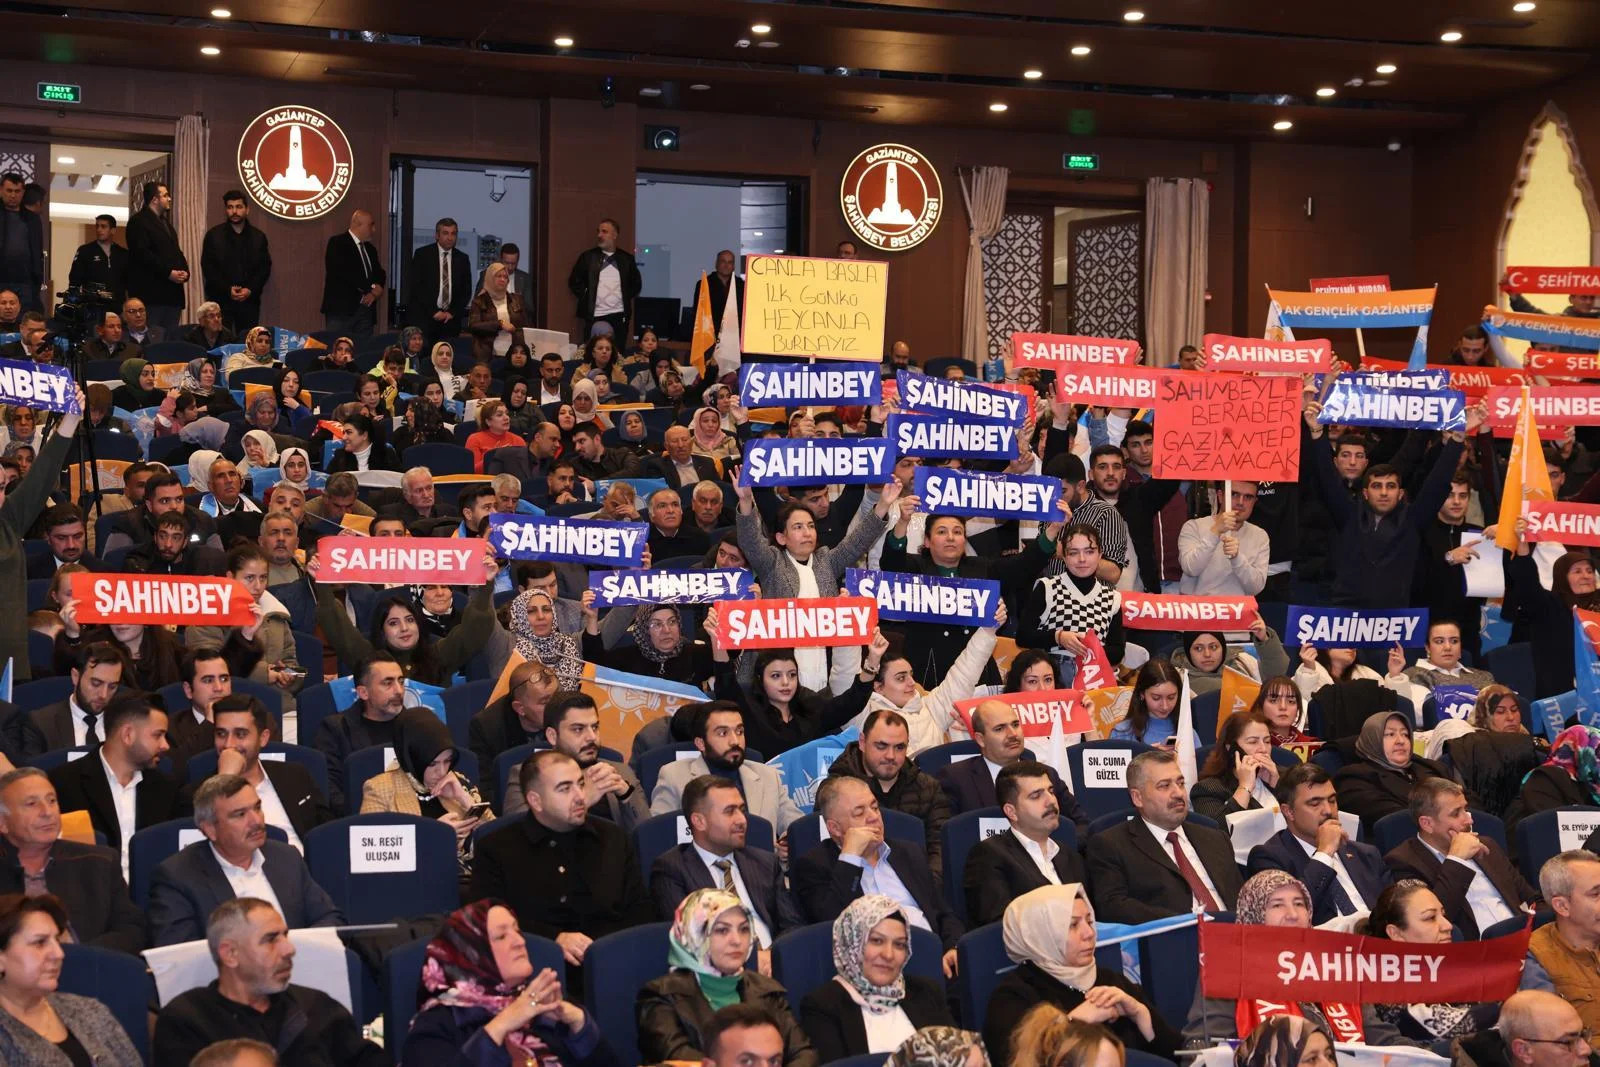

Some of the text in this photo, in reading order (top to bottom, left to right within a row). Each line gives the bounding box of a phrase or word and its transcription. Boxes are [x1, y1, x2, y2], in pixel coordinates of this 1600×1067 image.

[46, 85, 72, 93] EXIT
[265, 109, 325, 128] GAZİANTEP
[866, 147, 919, 165] GAZİANTEP
[241, 159, 349, 217] ŞAHİNBEY BELEDİYESİ
[843, 194, 887, 246] ŞAHİNBEY
[751, 257, 816, 278] CANLA
[763, 307, 871, 331] HEYCANLA
[1284, 302, 1434, 319] AK GENÇLİK GAZİANTEP
[1506, 318, 1522, 328] AK
[749, 365, 876, 403] ŞAHİNBEY
[906, 378, 1021, 421] ŞAHİNBEY
[1191, 400, 1296, 426] BERABER
[1330, 389, 1458, 423] ŞAHİNBEY
[897, 418, 1015, 454] ŞAHİNBEY
[749, 440, 887, 483] ŞAHİNBEY
[1160, 448, 1298, 473] KAZANACAK
[925, 473, 1056, 514] ŞAHİNBEY
[500, 519, 639, 558] ŞAHİNBEY
[602, 570, 742, 603] ŞAHİNBEY
[728, 602, 872, 645] ŞAHİNBEY
[1296, 612, 1420, 645] ŞAHİNBEY
[1088, 757, 1126, 766] SN. CUMA
[1096, 769, 1120, 780] GÜZEL
[361, 835, 403, 848] SN. REŞİT
[365, 851, 400, 862] ULUŞAN
[1277, 946, 1445, 985] ŞAHİNBEY
